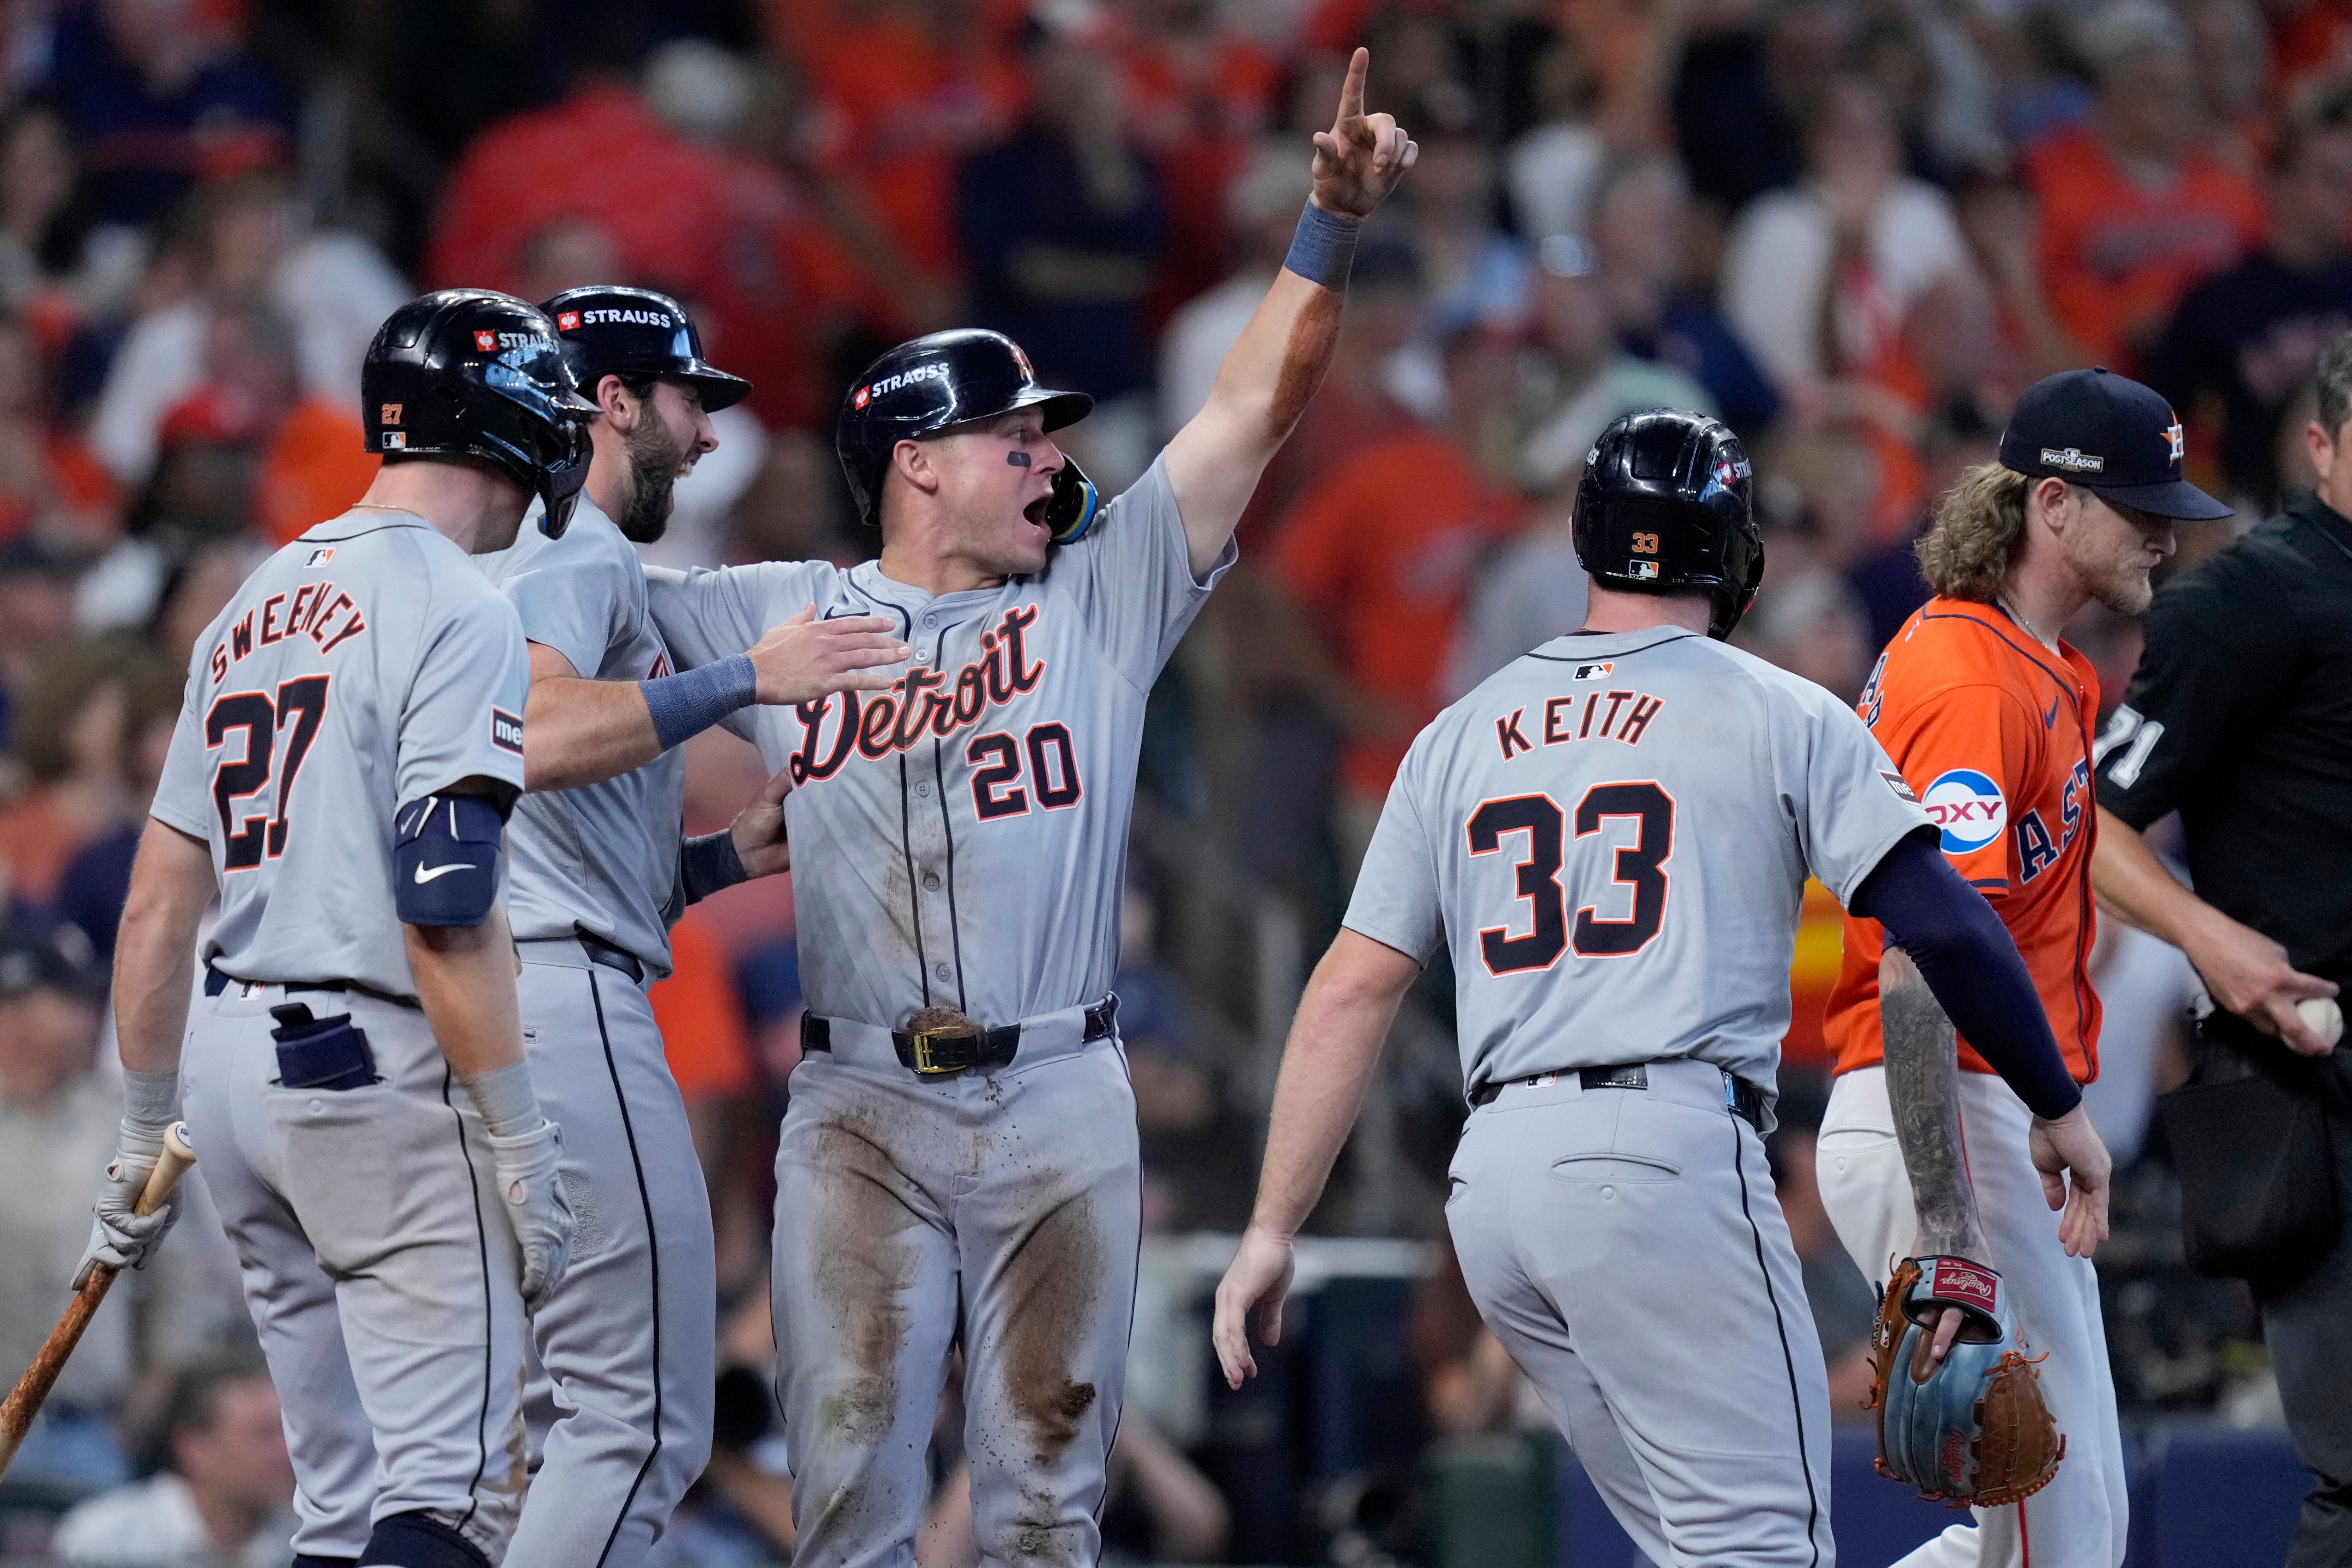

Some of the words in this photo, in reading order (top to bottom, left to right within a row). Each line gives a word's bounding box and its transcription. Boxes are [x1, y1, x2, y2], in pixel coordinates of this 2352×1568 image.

[583, 309, 670, 329] STRAUSS
[498, 332, 560, 355] STRAUSS
[872, 362, 949, 398] STRAUSS
[381, 404, 403, 424] 27
[2043, 452, 2101, 470] POSTSEASON
[1632, 533, 1658, 553] 33
[211, 580, 366, 685] SWEENEY
[789, 602, 1047, 790] Detroit
[496, 719, 523, 746] me
[1495, 689, 1666, 764] KEITH
[2092, 703, 2165, 790] 71
[204, 673, 331, 876] 27
[965, 720, 1085, 823] 20
[1888, 780, 1915, 796] me
[1464, 779, 1677, 979] 33
[1940, 1272, 1992, 1297] Rawlings
